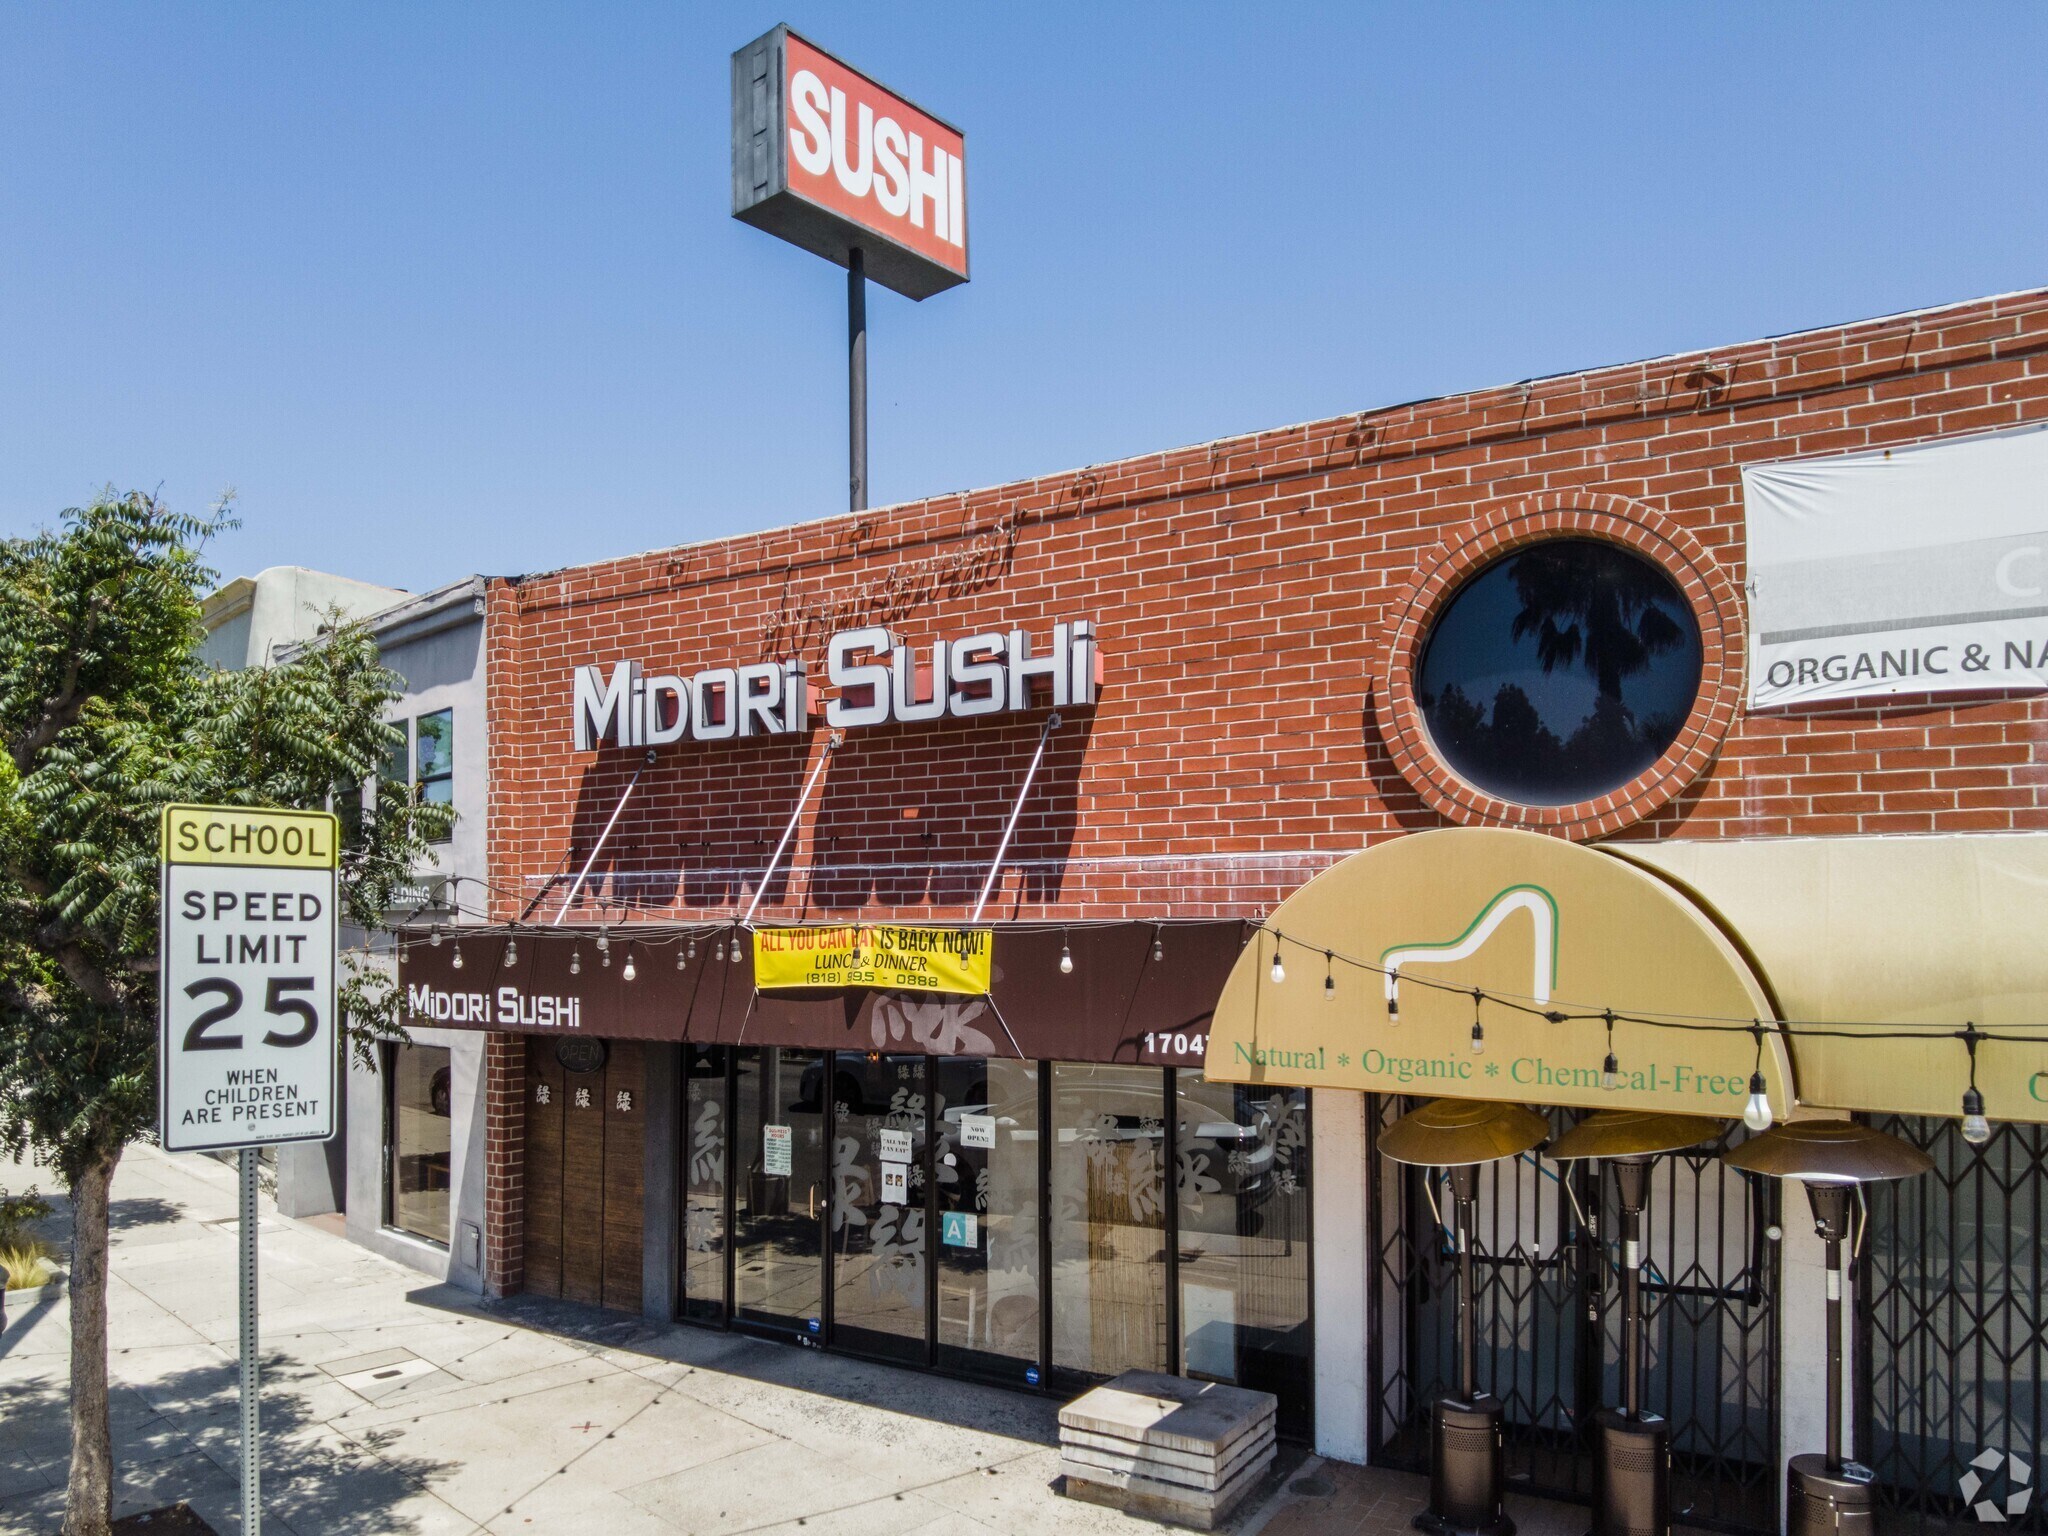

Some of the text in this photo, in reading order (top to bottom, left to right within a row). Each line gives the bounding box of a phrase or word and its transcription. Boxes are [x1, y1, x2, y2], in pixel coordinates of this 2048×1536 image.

[790, 70, 963, 248] SUSHI
[1767, 646, 1949, 688] ORGANIC
[1961, 643, 1991, 672] &
[178, 820, 326, 857] SCHOOL
[181, 890, 322, 921] SPEED
[197, 934, 307, 964] LIMIT
[761, 930, 785, 952] ALL
[788, 929, 815, 951] YOU
[819, 928, 847, 949] CAN
[880, 927, 894, 949] IS
[899, 928, 938, 953] BACK
[943, 930, 984, 955] NOW!
[815, 953, 927, 972] LUNC & DINNER
[806, 972, 840, 984] (818)
[896, 974, 938, 987] 0888
[182, 976, 319, 1052] 25
[560, 1044, 600, 1061] OPEN
[227, 1068, 278, 1085] WHEN
[1234, 1041, 1745, 1096] Natural Organic Chemcal-Free
[205, 1084, 298, 1105] CHILDREN
[182, 1100, 319, 1125] ARE PRESENT
[947, 1219, 962, 1239] A
